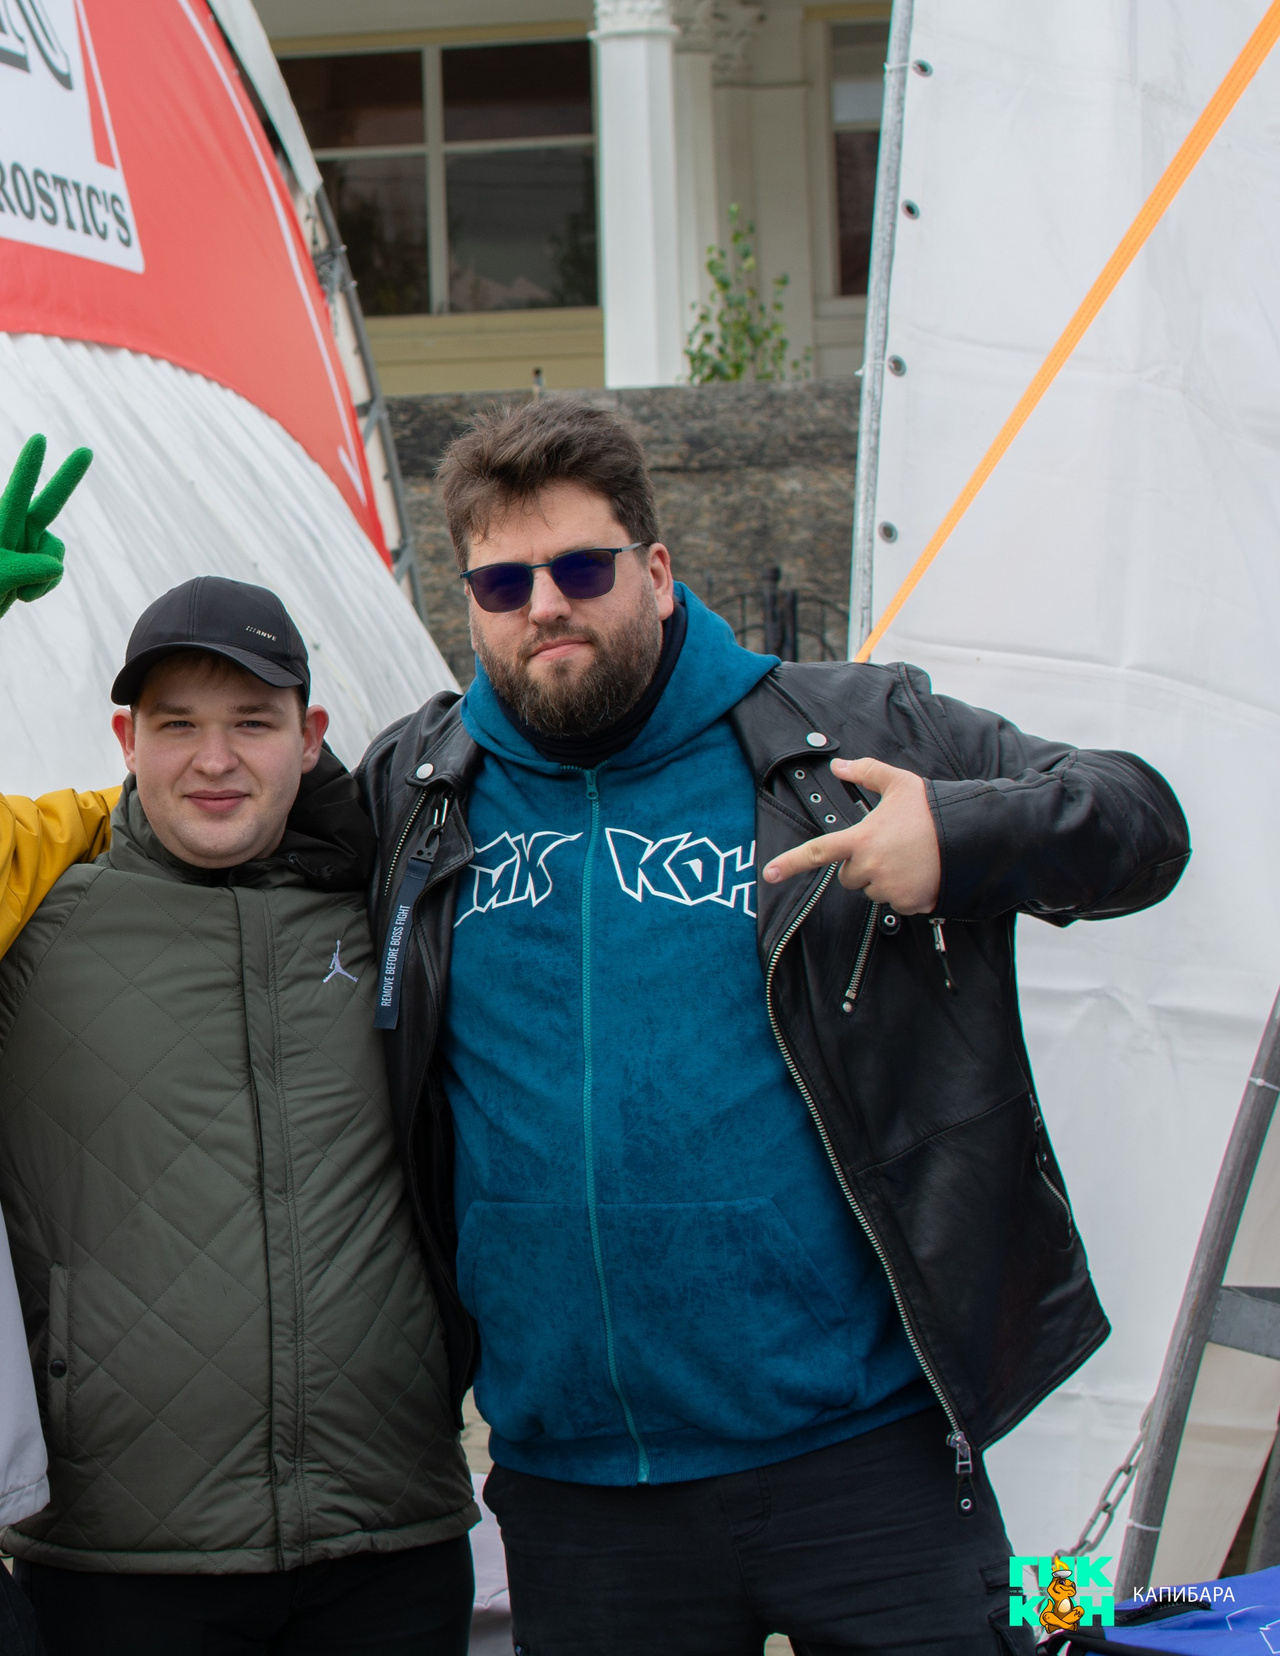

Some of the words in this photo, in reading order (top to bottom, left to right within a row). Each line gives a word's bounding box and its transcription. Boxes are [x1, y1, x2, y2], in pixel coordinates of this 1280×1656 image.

[395, 904, 411, 925] FIGHT
[390, 926, 404, 946] BOSS
[385, 947, 399, 975] BEFORE
[381, 976, 395, 1007] REMOVE
